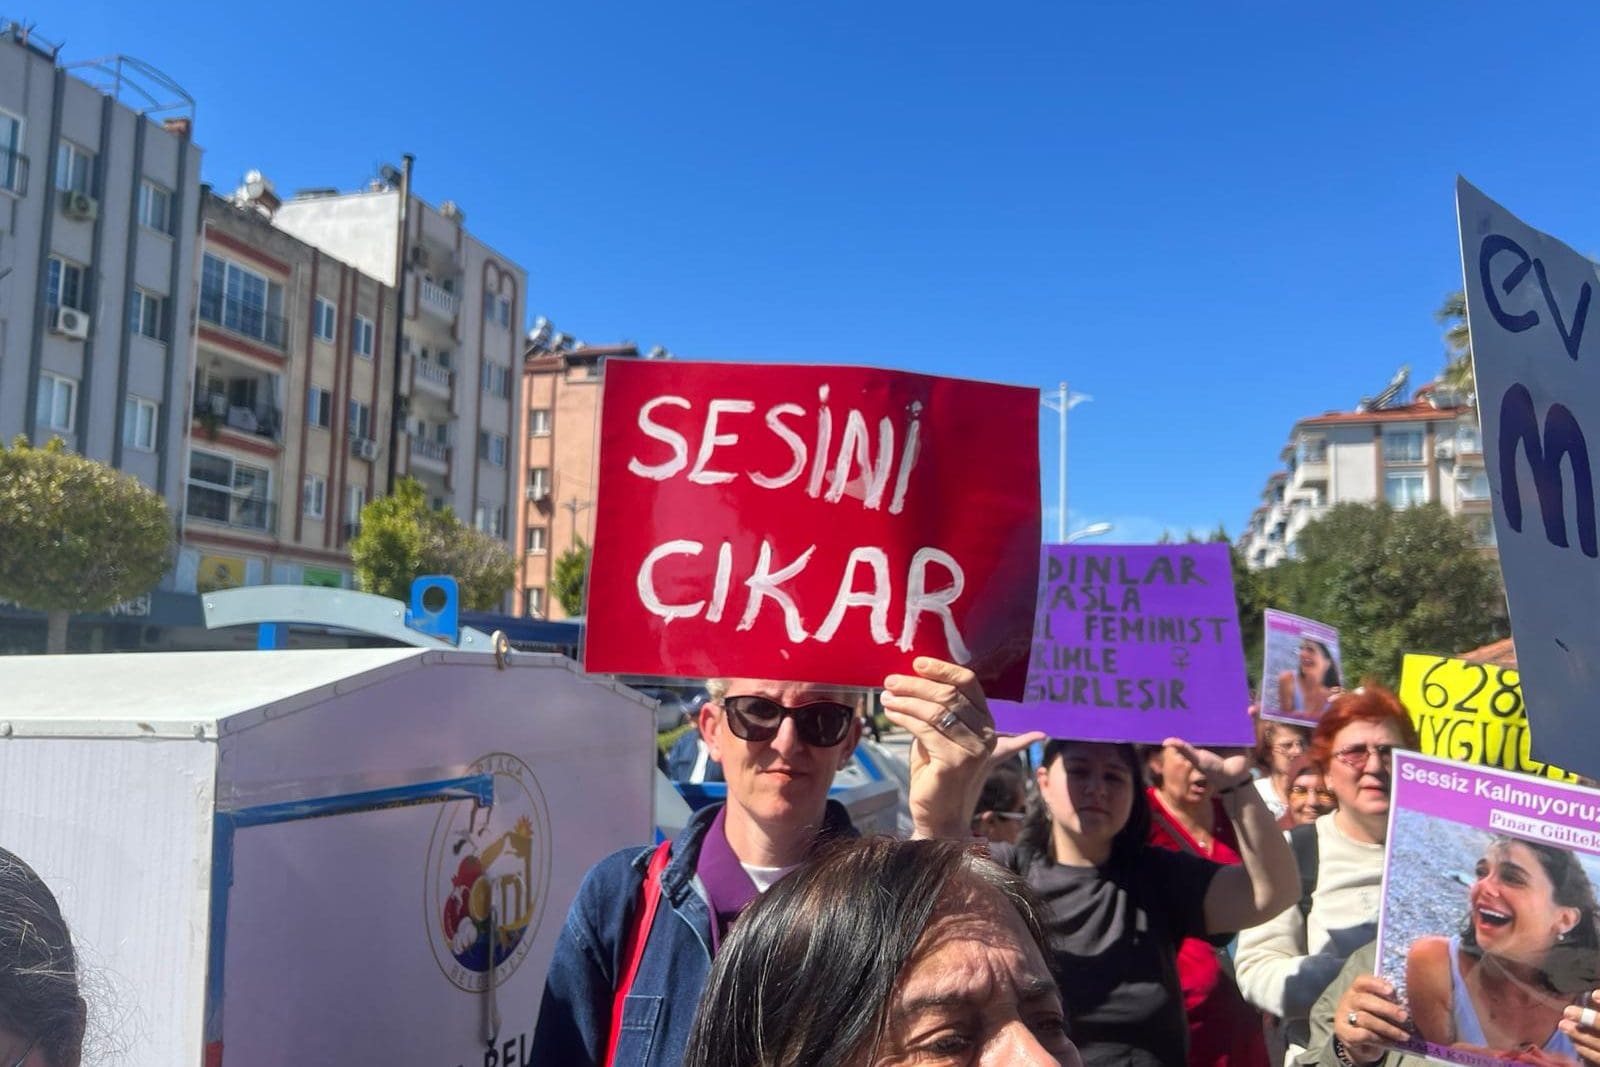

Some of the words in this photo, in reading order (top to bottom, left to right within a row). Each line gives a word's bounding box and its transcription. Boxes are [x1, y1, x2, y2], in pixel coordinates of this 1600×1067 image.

[1421, 659, 1528, 720] 628
[1400, 762, 1471, 795] Sessiz
[1491, 812, 1536, 834] Pınar
